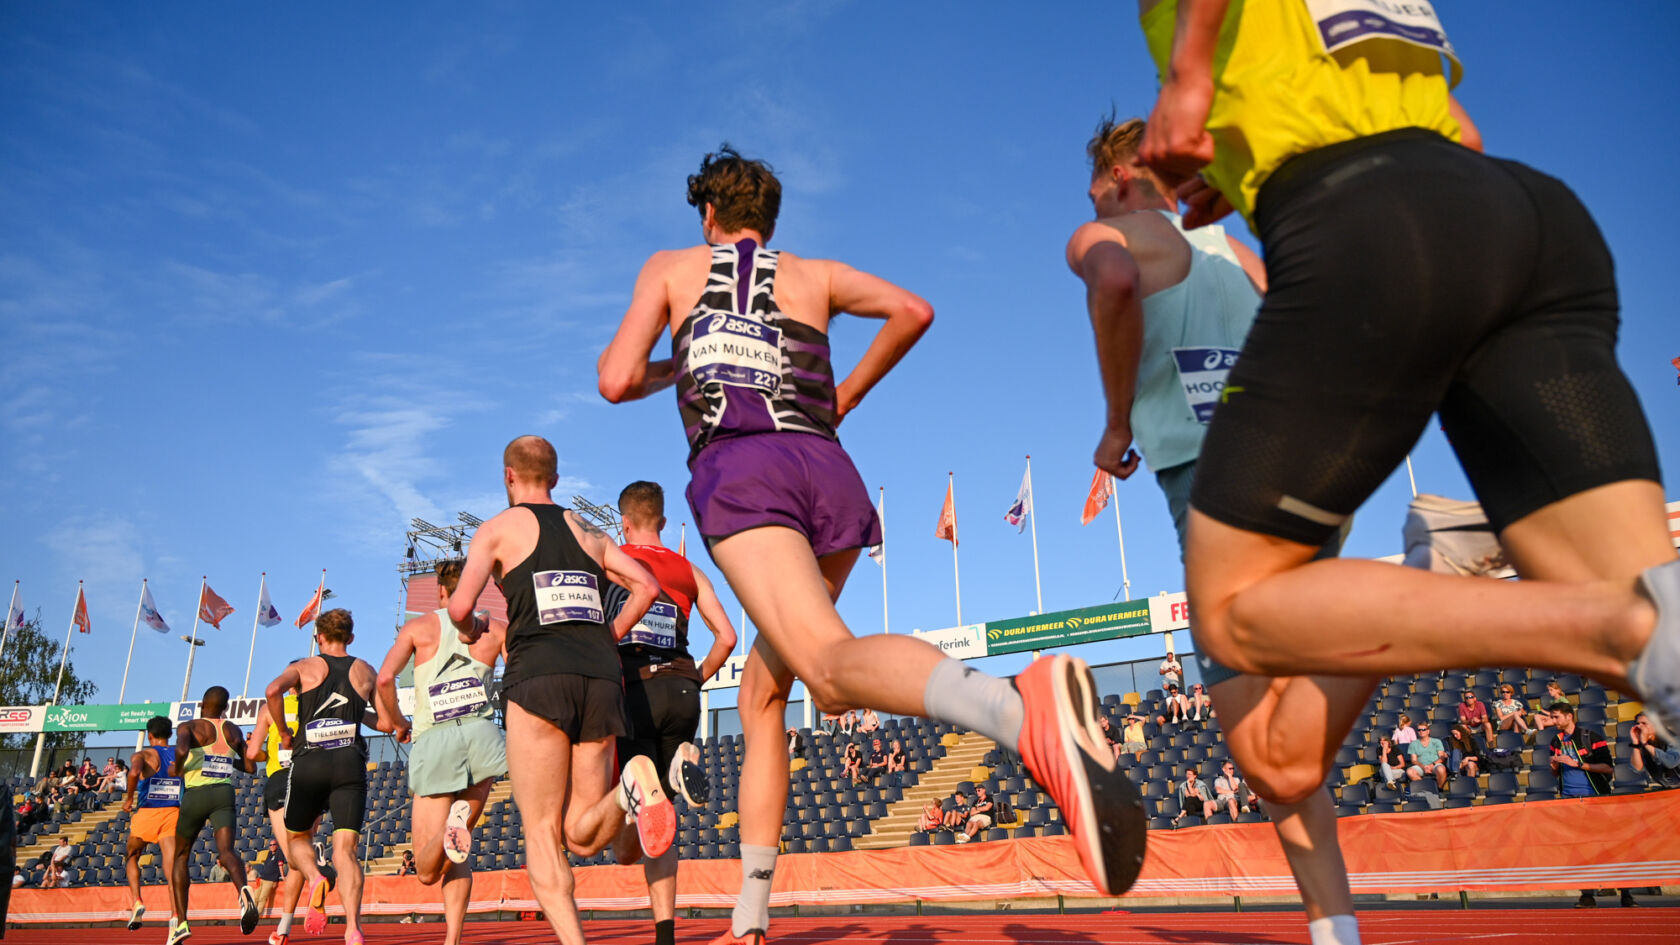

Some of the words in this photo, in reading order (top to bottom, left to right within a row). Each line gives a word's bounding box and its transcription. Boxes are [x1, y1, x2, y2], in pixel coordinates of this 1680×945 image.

[725, 318, 762, 337] asics
[692, 343, 717, 359] VAN
[723, 343, 778, 366] MULKEN
[754, 371, 777, 388] 221
[1186, 382, 1225, 394] HOO
[564, 574, 588, 585] asics
[551, 593, 566, 601] DE
[569, 593, 593, 602] HAAN
[1083, 616, 1107, 625] DURA
[1107, 608, 1149, 622] VERMEER
[1003, 627, 1026, 637] DURA
[1026, 621, 1065, 634] VERMEER
[657, 636, 672, 646] 141
[450, 679, 470, 690] asics
[433, 690, 483, 707] POLDERMAN
[314, 729, 349, 738] TIELSEMA
